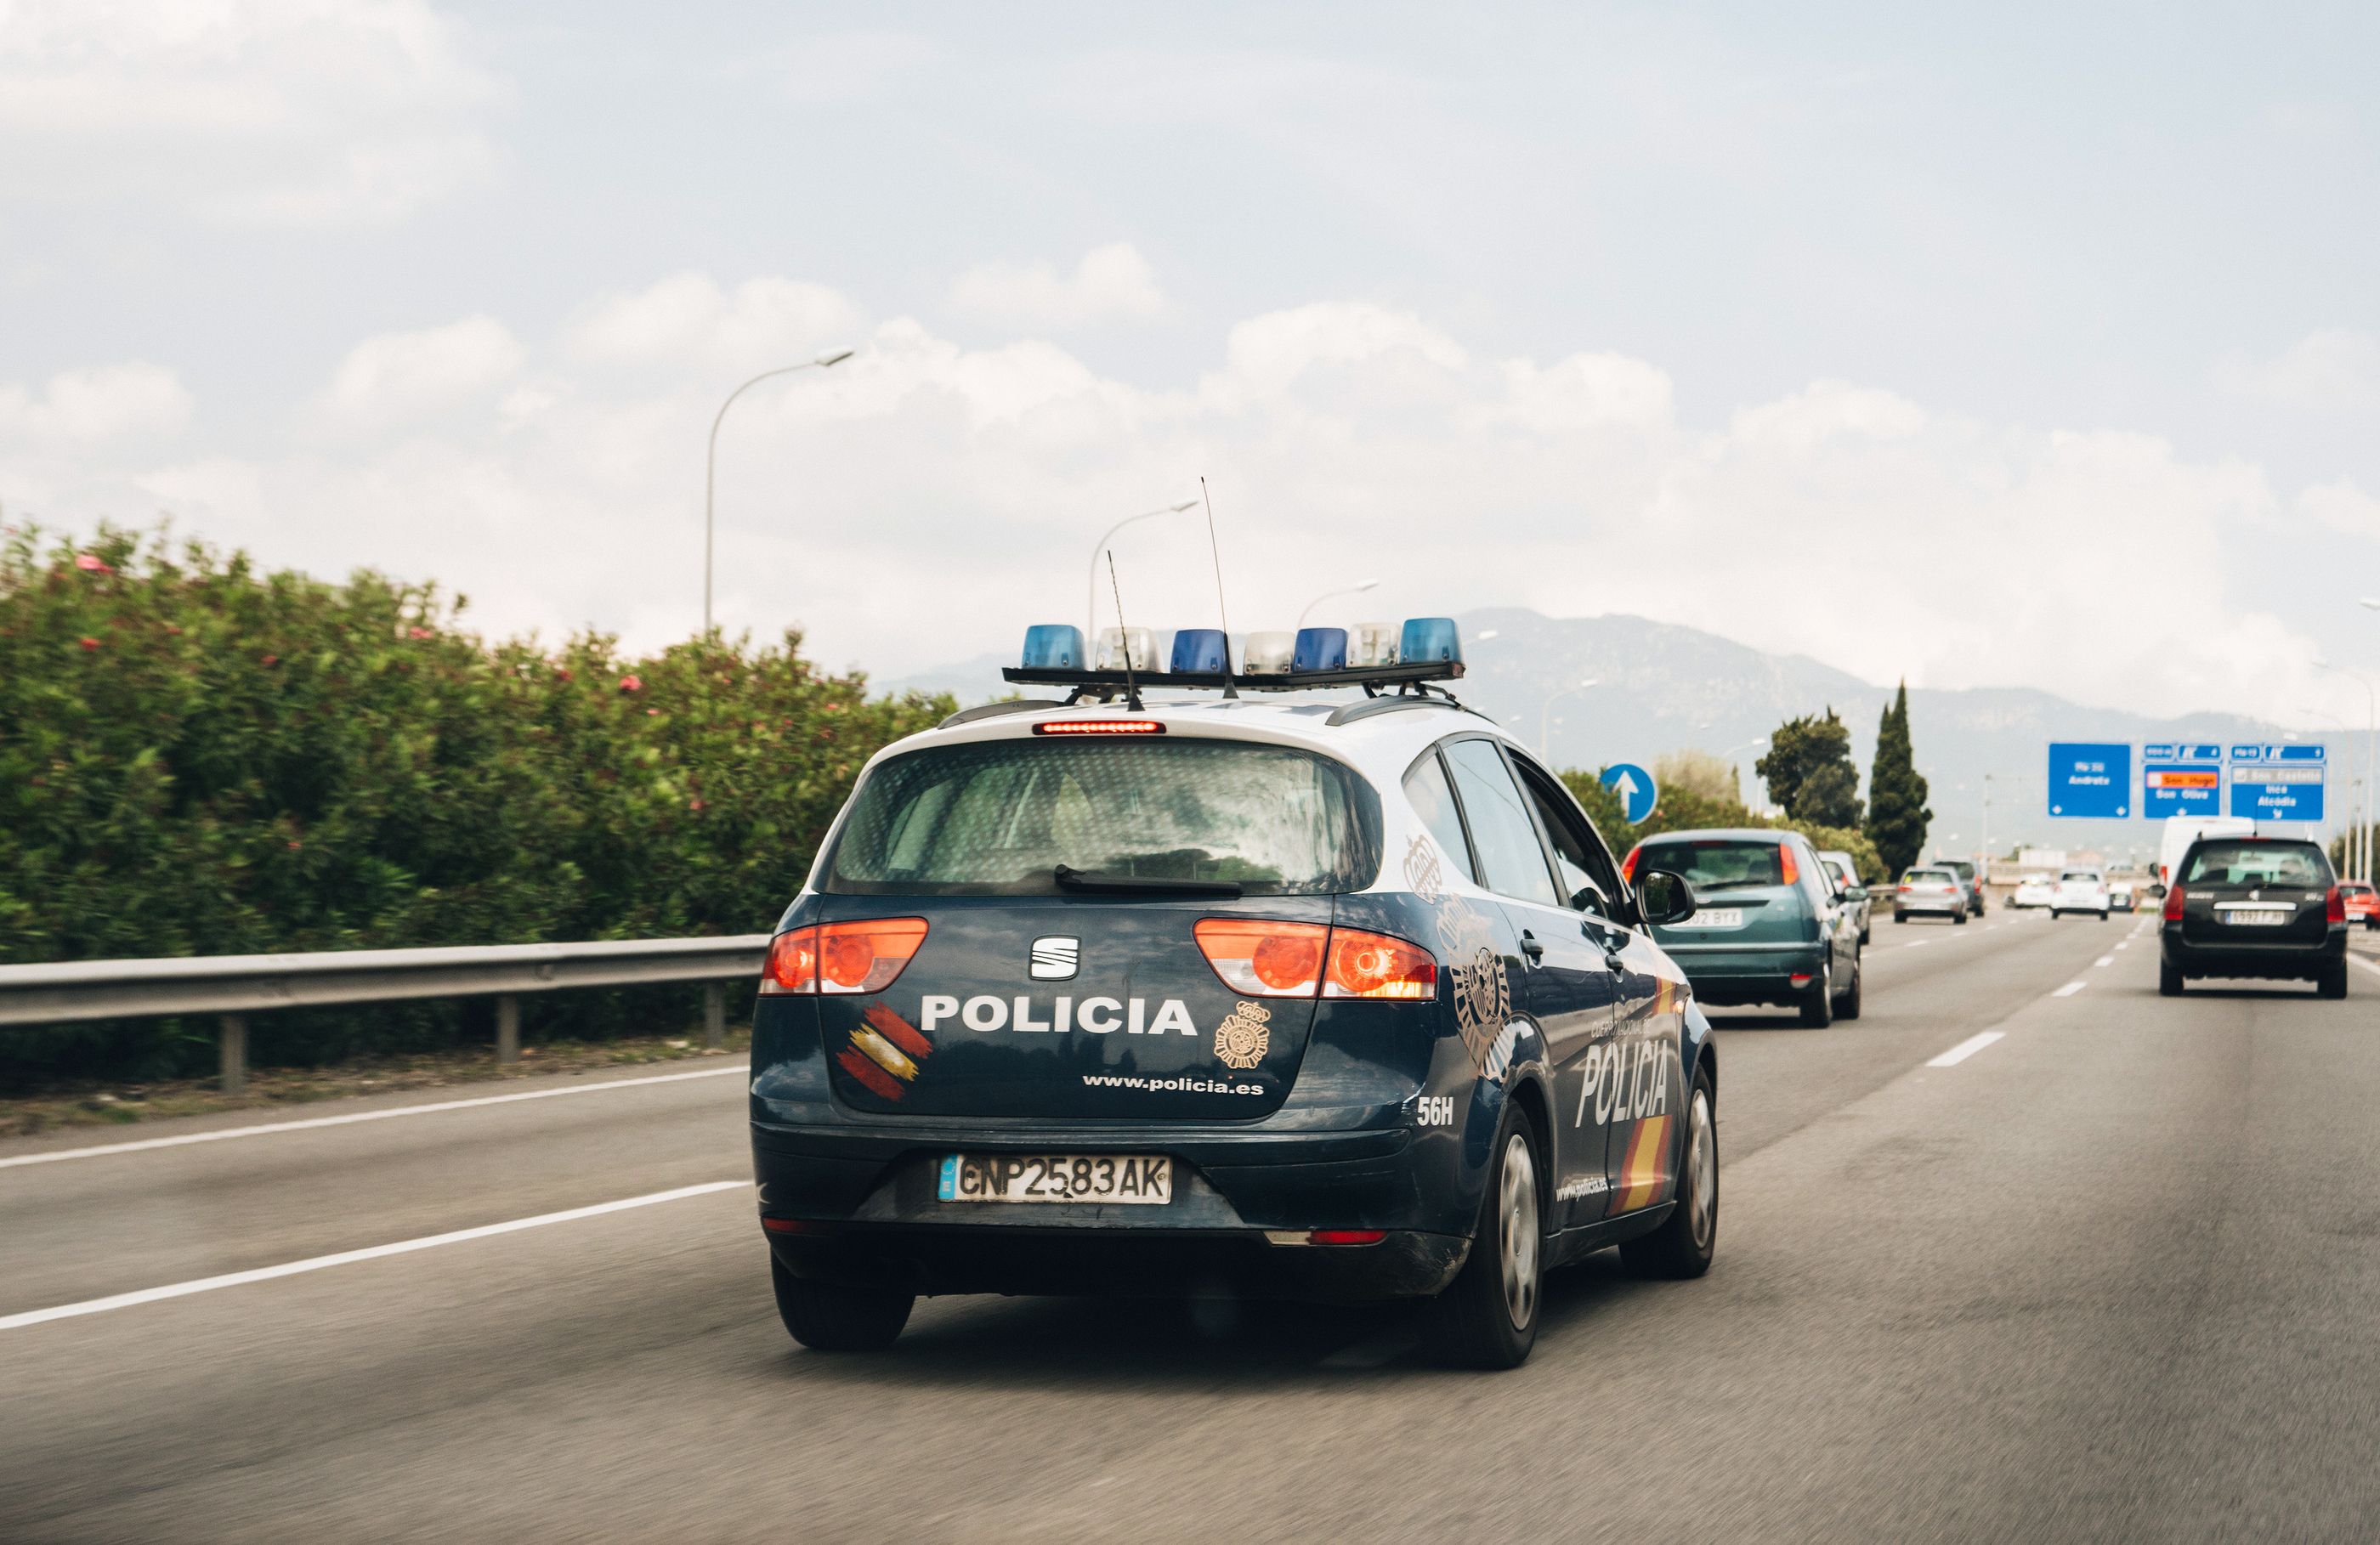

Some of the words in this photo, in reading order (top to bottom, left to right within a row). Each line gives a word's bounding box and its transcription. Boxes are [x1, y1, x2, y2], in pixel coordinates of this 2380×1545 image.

[921, 995, 1198, 1036] POLICIA
[1082, 1074, 1265, 1096] www.policia.es
[1575, 1039, 1668, 1128] POLICIA
[1417, 1096, 1454, 1127] 56H
